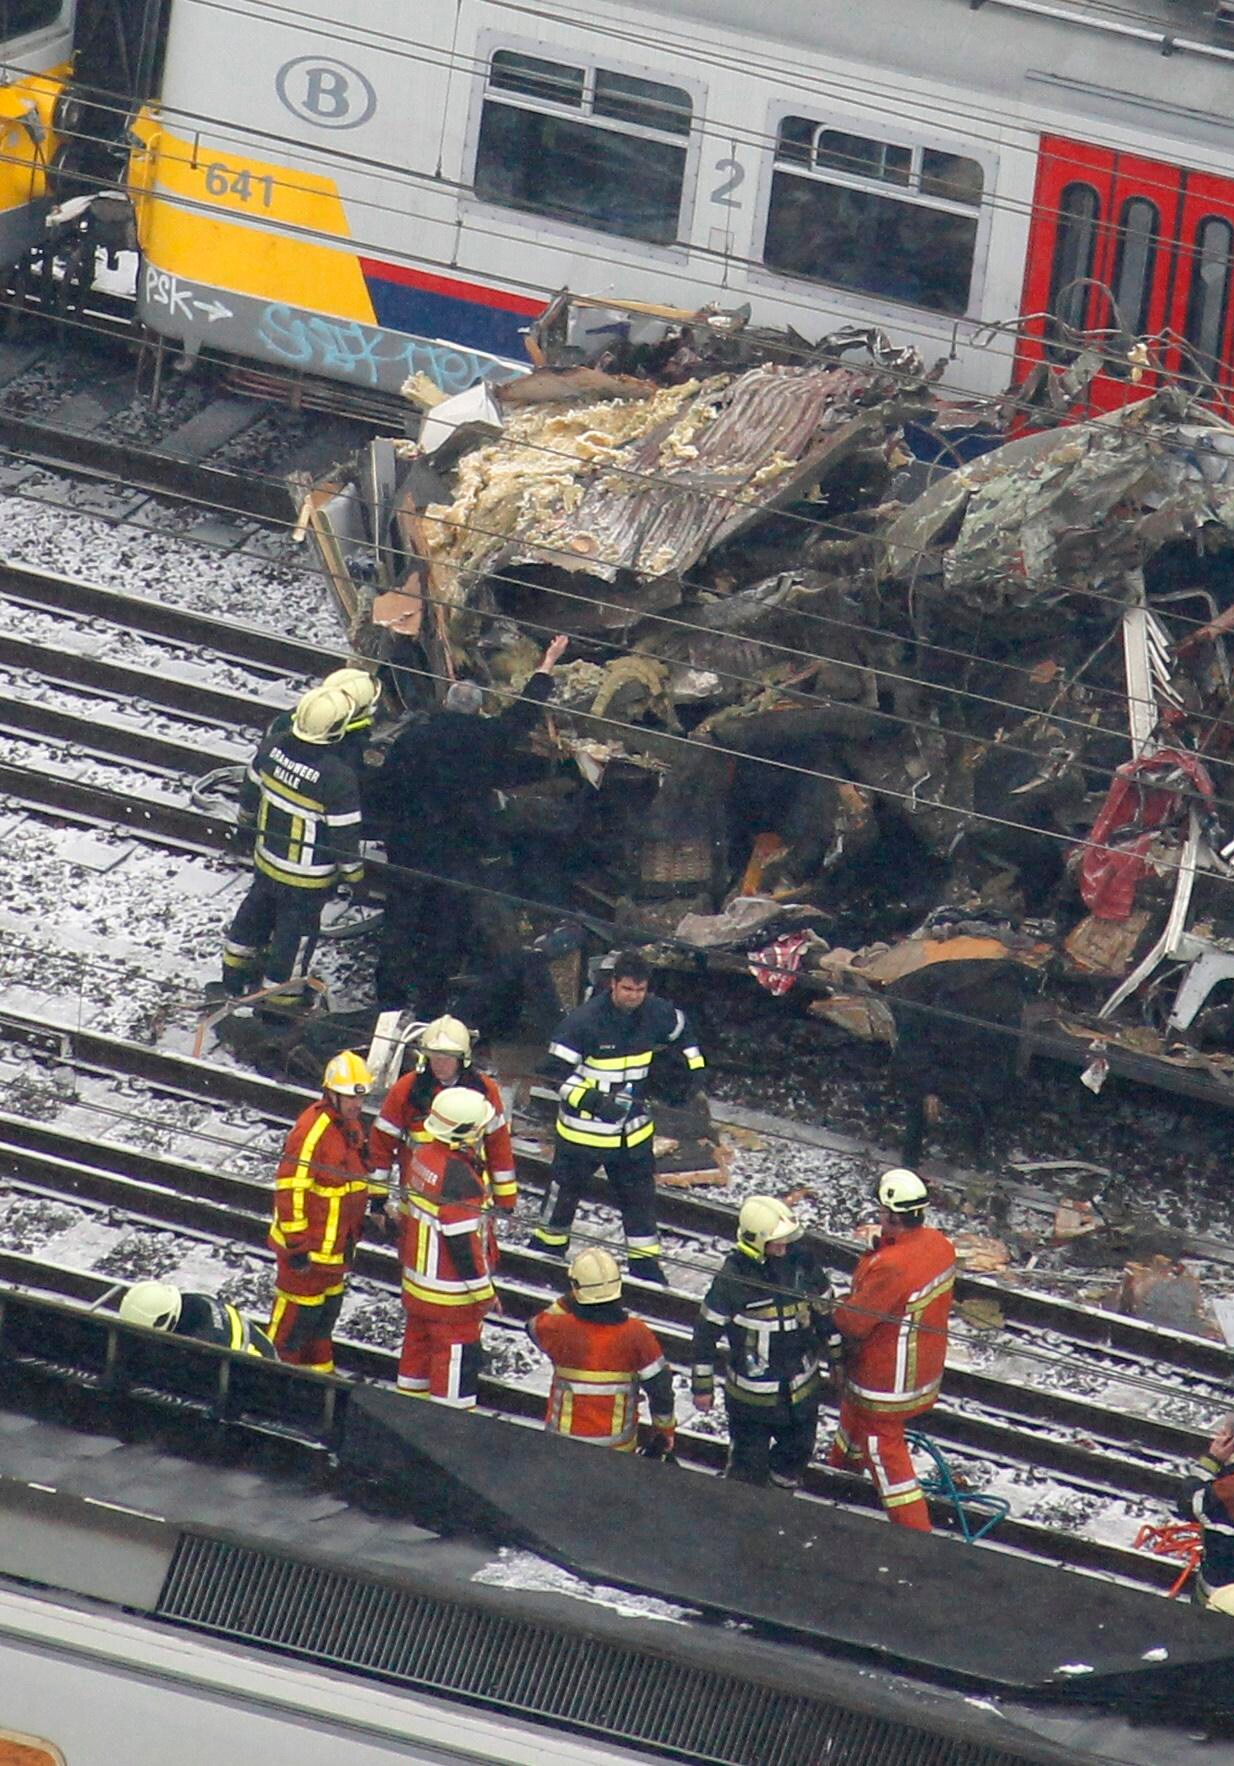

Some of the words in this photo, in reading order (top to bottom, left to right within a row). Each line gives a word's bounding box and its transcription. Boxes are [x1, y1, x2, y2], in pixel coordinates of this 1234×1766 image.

[301, 67, 350, 118] B
[205, 162, 274, 207] 641
[710, 158, 745, 209] 2
[145, 269, 194, 320] PSK
[269, 747, 320, 784] BRANDWEER
